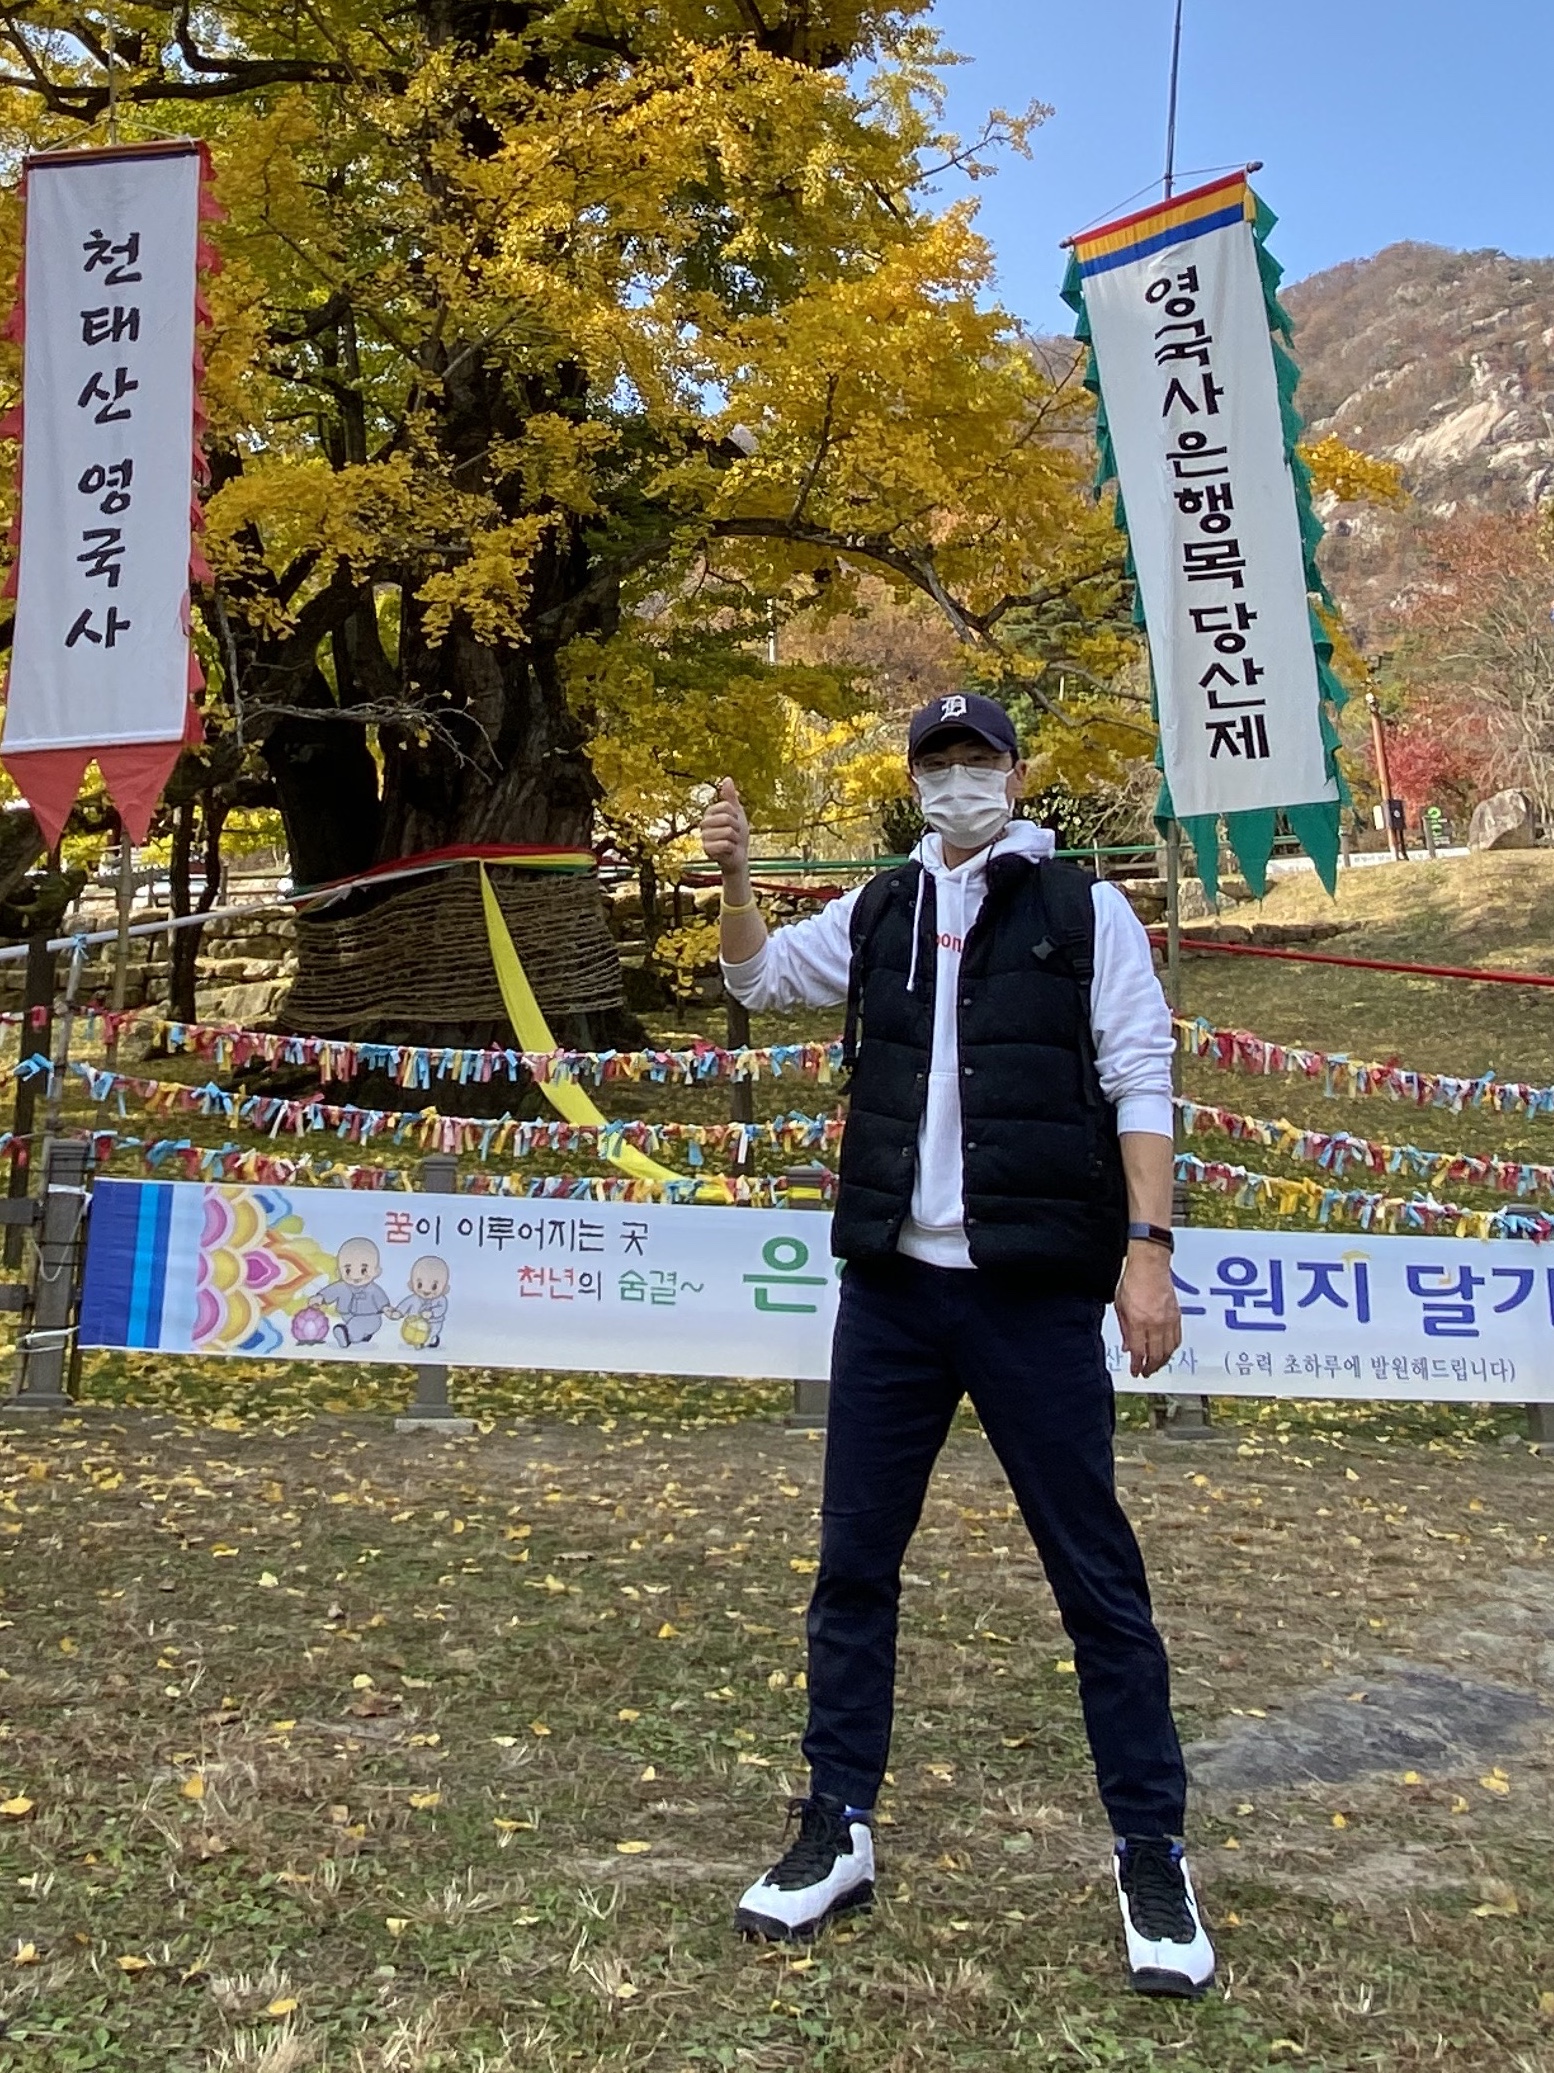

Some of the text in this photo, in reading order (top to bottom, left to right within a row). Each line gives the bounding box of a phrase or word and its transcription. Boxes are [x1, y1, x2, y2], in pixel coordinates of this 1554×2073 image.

[64, 229, 143, 649] 천태산 영국사
[384, 1211, 650, 1257] 꿈이 이루어지는 곳
[517, 1265, 602, 1302] 천년의
[1405, 1264, 1554, 1338] 달기
[1224, 1350, 1516, 1383] (음력 초하루에 발원해드립니다)
